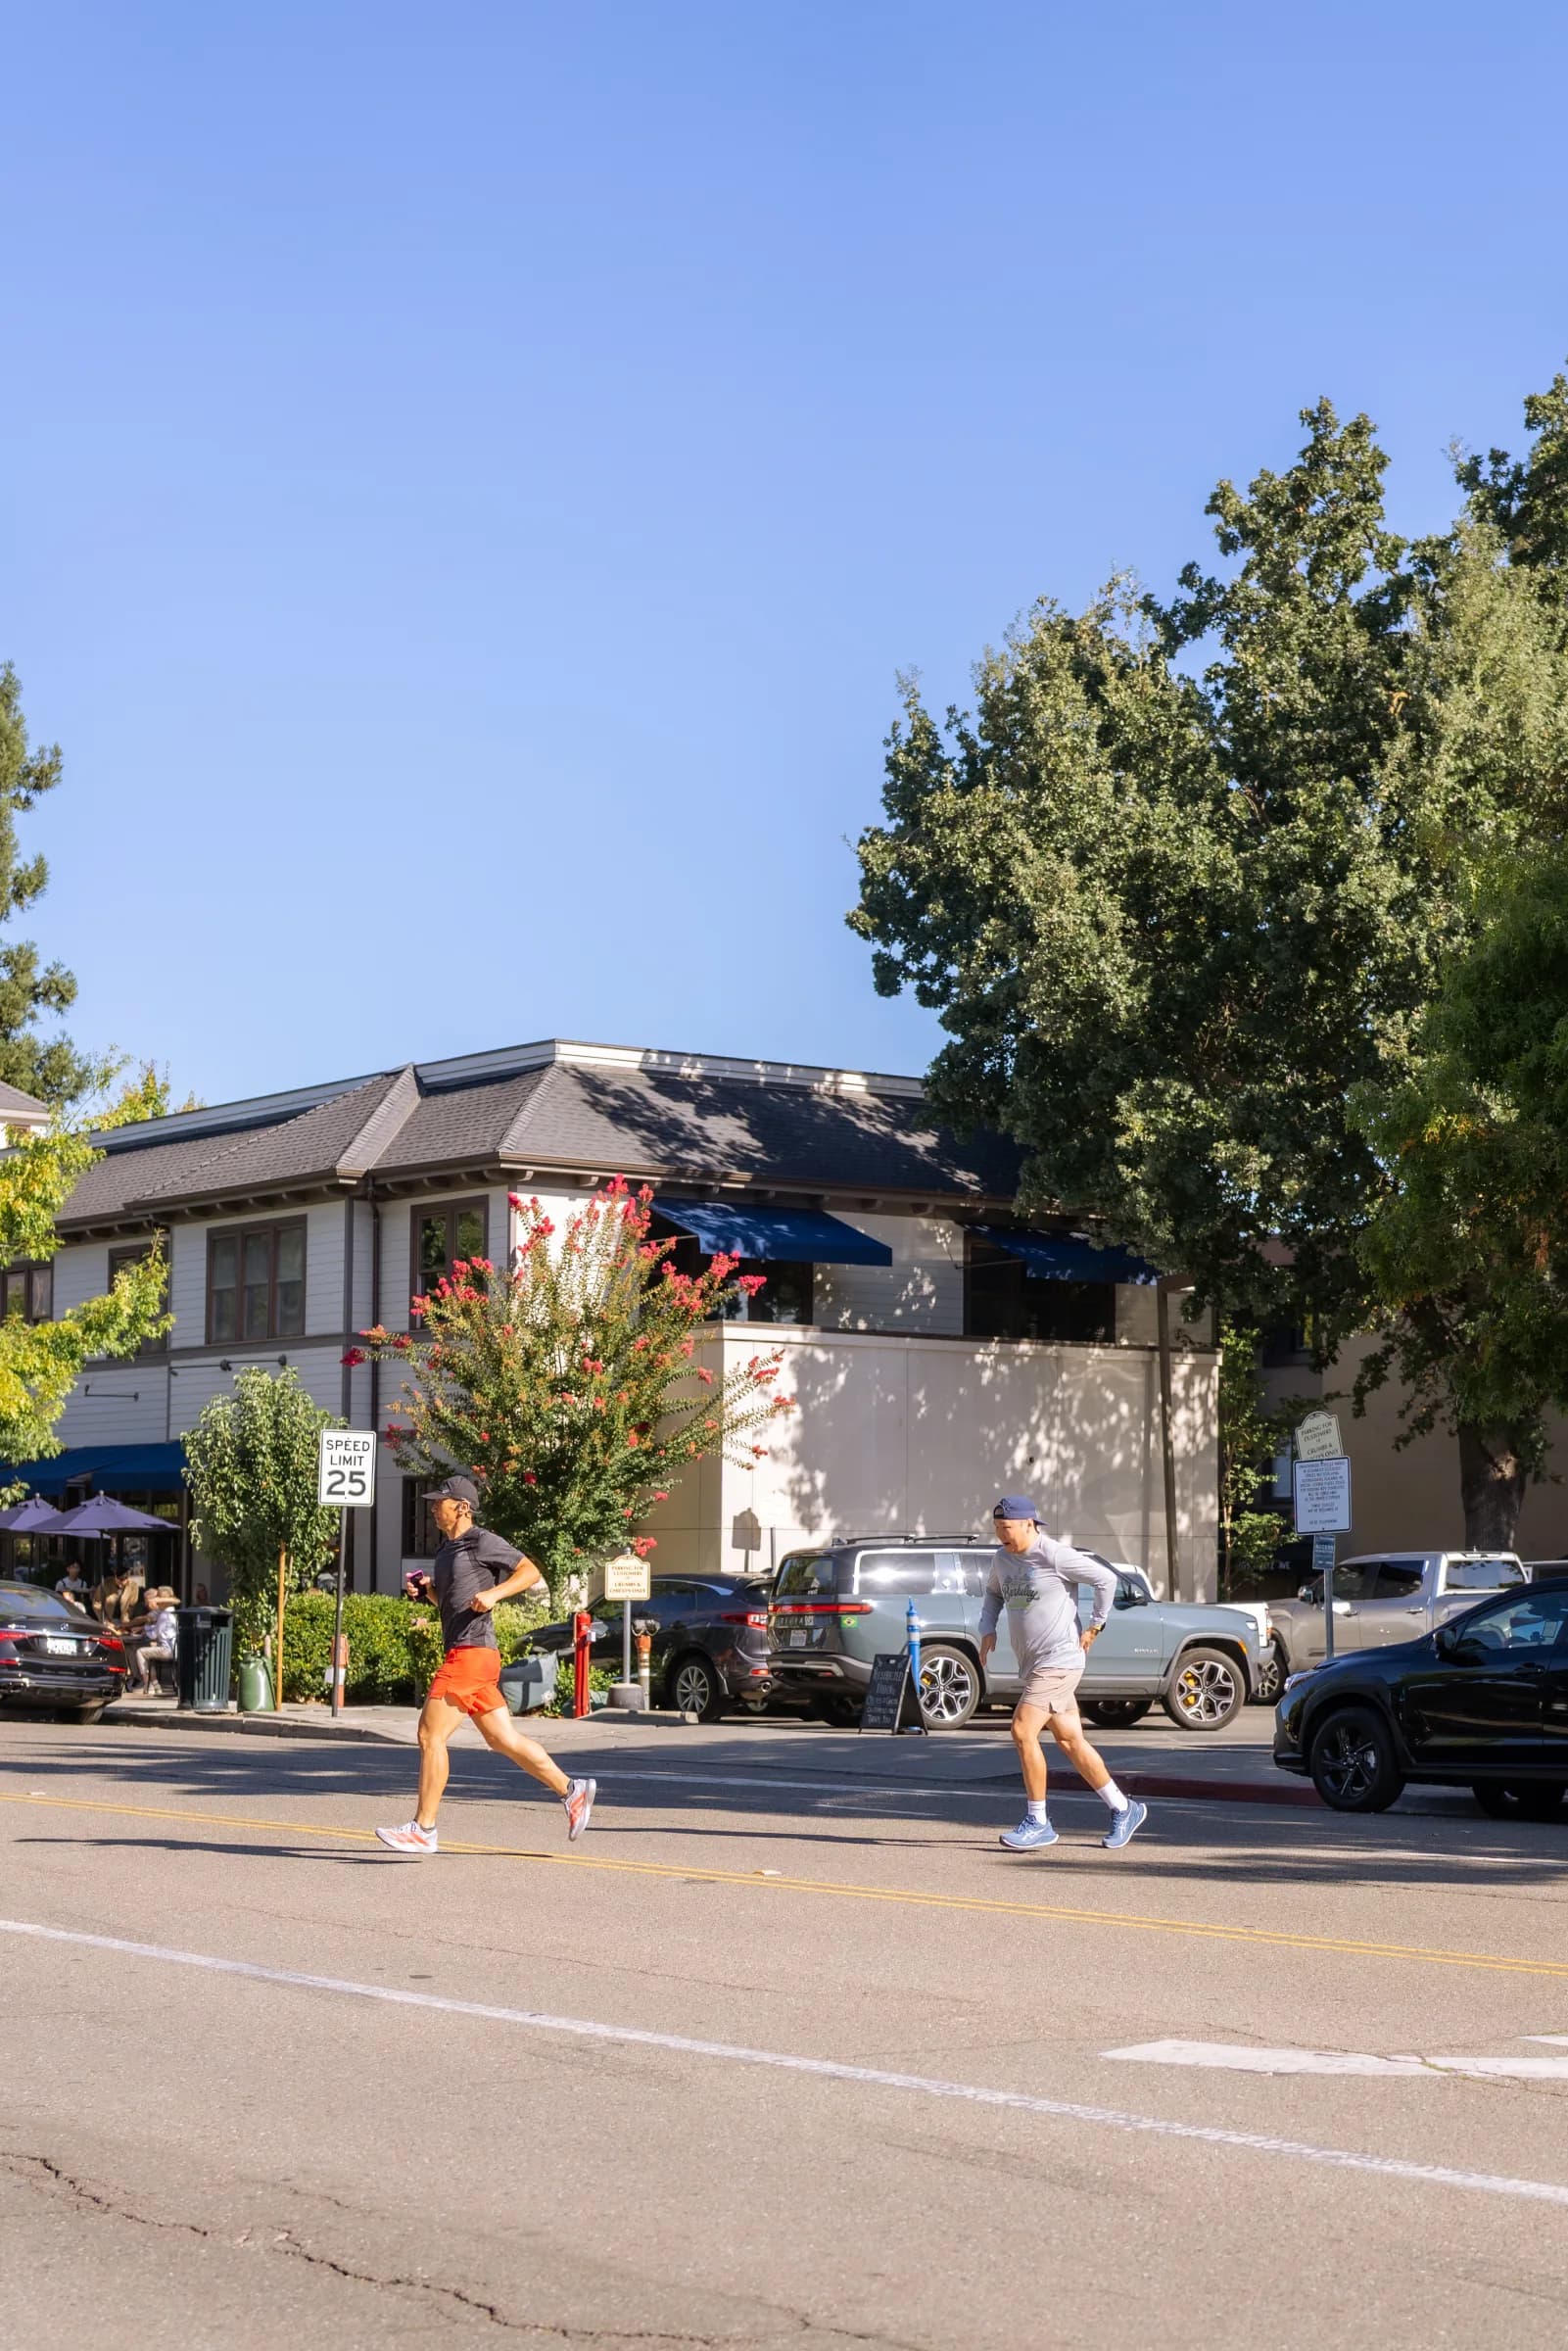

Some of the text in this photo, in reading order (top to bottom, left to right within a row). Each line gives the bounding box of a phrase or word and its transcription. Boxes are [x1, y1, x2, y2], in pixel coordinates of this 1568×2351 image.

[326, 1439, 370, 1452] SPEED
[330, 1454, 364, 1465] LIMIT
[326, 1469, 366, 1497] 25
[1002, 1583, 1041, 1603] Berkeley
